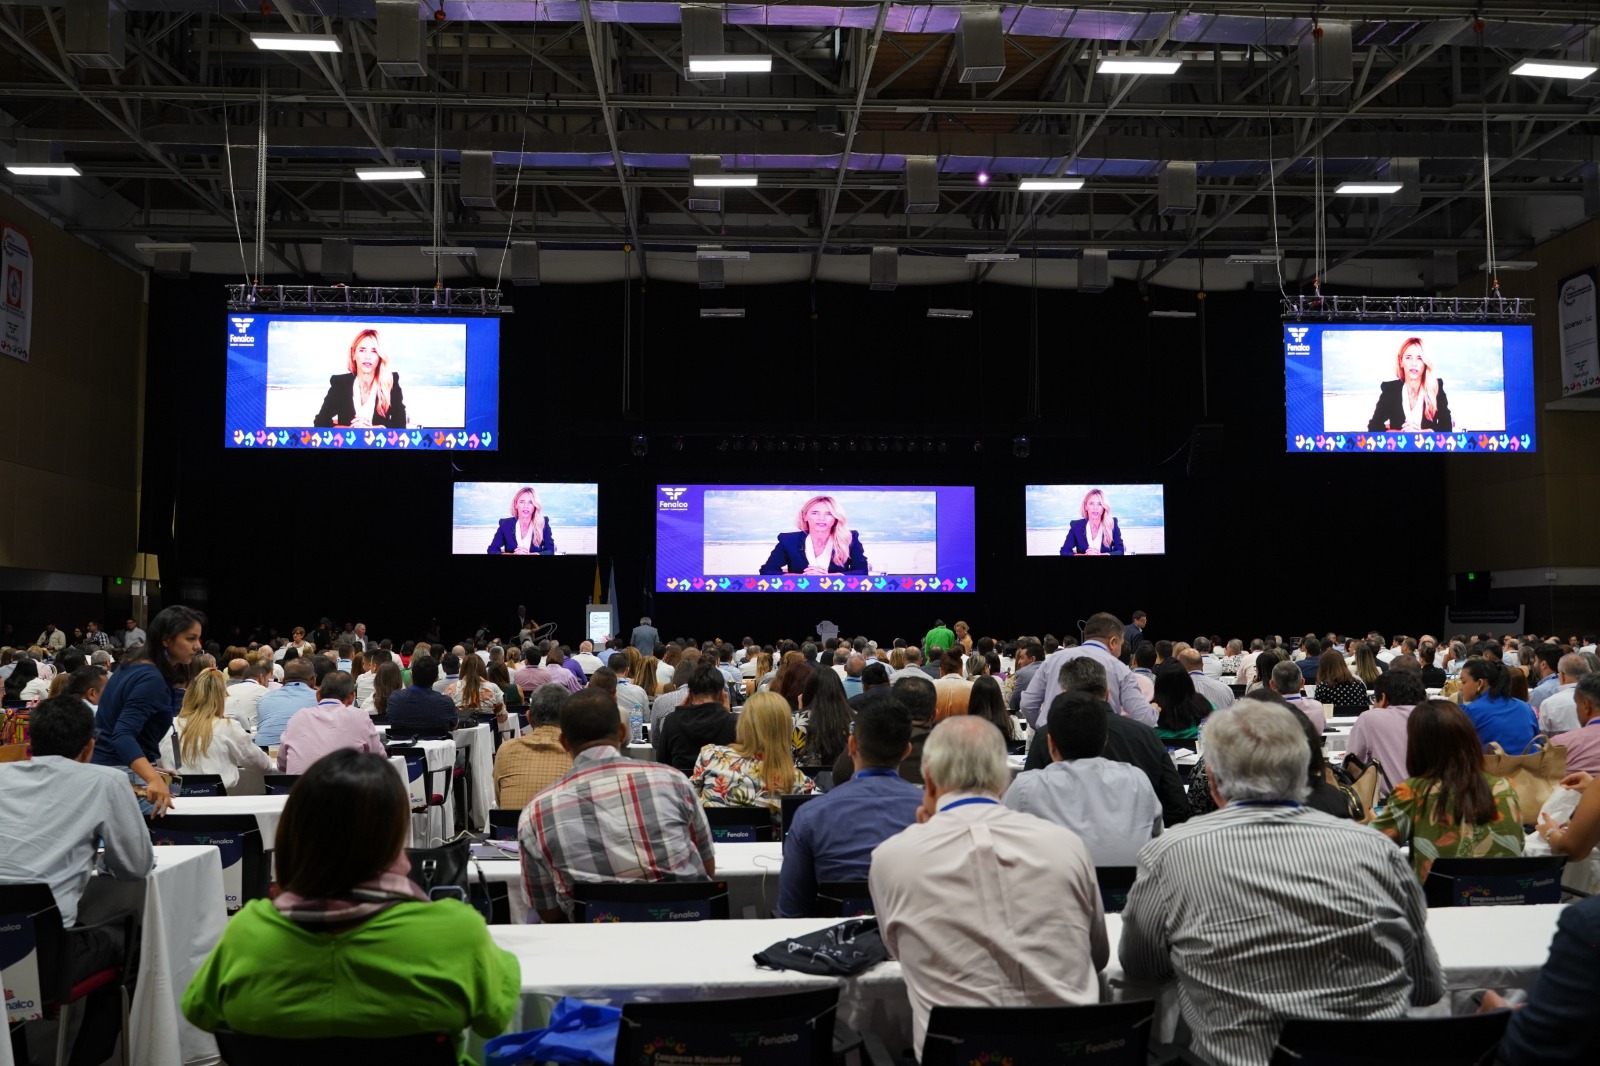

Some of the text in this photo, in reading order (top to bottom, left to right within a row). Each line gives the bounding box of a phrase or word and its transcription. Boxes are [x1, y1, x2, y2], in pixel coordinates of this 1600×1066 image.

[229, 334, 255, 343] Fenalco
[1287, 343, 1310, 352] Fenalco
[659, 500, 688, 508] Fenalco
[1532, 878, 1554, 888] Fenalco
[669, 910, 700, 919] Fenalco
[6, 1000, 34, 1010] nalco
[758, 1032, 799, 1047] Fenalco
[1086, 1038, 1126, 1054] Fenalco
[654, 1052, 693, 1063] Congreso
[694, 1055, 730, 1063] Nacional
